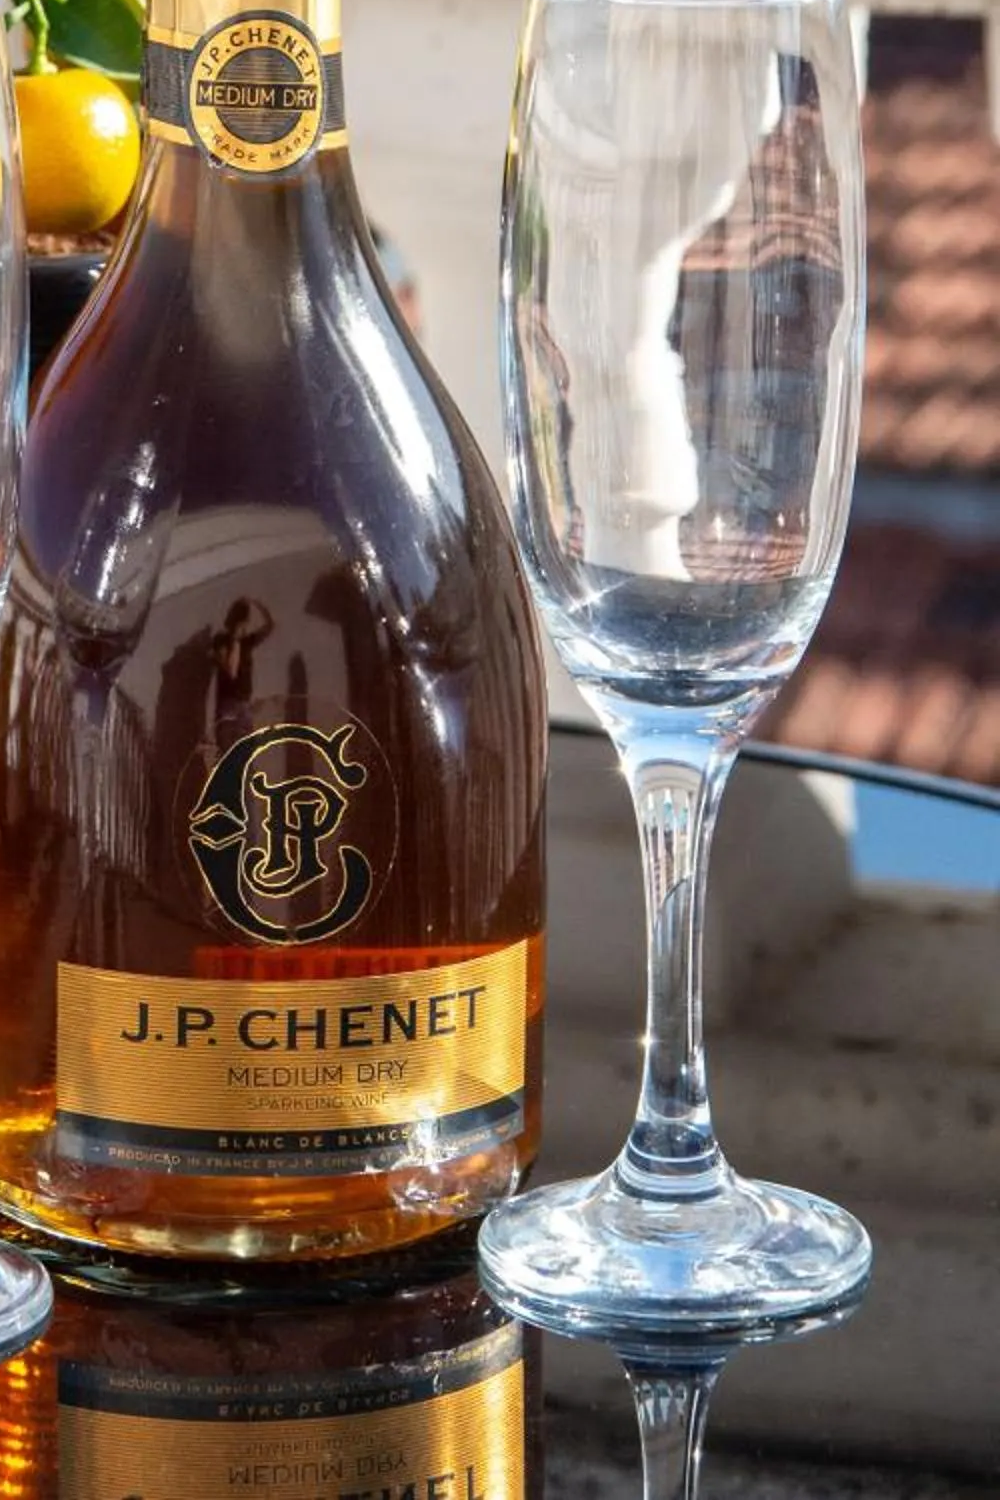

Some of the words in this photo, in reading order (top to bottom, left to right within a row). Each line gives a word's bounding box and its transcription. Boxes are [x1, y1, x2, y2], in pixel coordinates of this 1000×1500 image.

[199, 84, 276, 107] MEDIUM
[283, 88, 316, 108] DRY
[209, 128, 258, 163] RADE
[238, 985, 487, 1051] CHENET
[228, 1064, 344, 1088] MEDIUM
[357, 1059, 409, 1084] DRY
[218, 1135, 285, 1149] BLANC
[299, 1135, 324, 1148] DE
